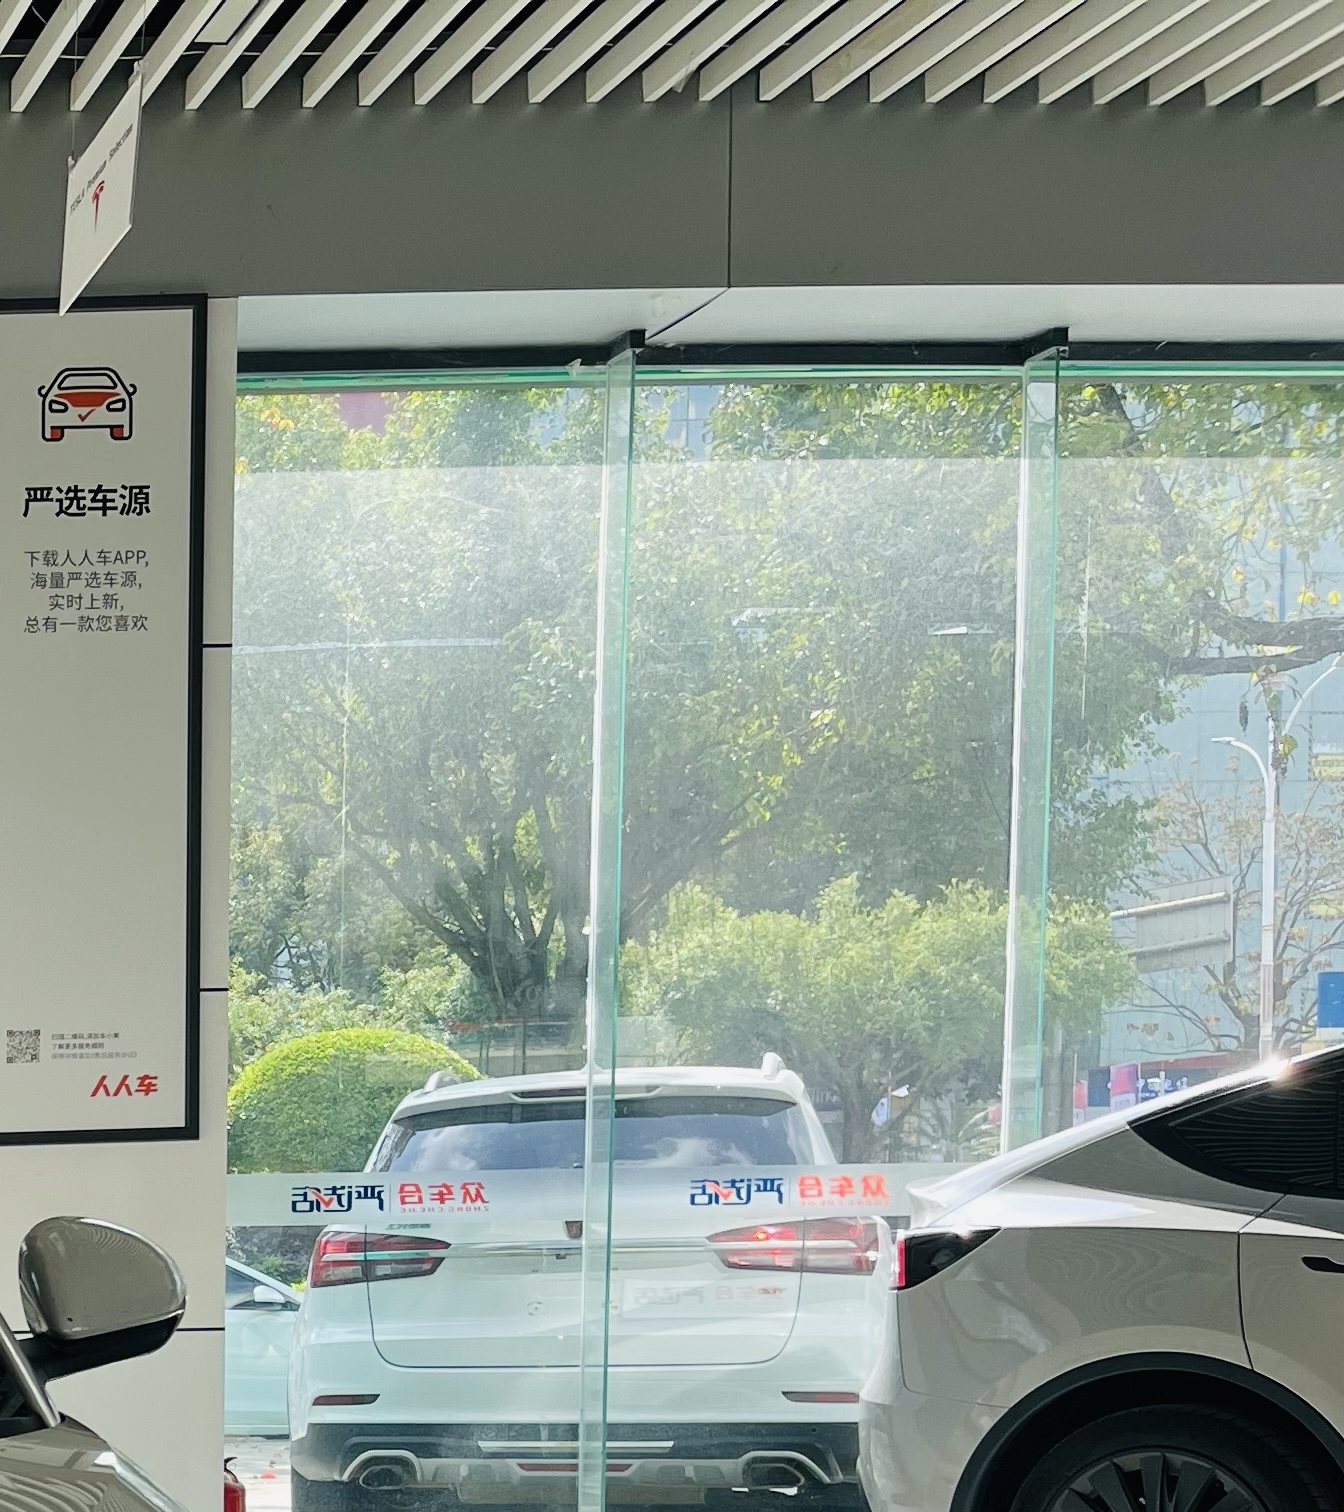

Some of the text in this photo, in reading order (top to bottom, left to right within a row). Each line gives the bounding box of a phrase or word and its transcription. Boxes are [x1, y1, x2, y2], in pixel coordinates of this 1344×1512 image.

[22, 484, 151, 518] 严选车源
[23, 614, 149, 634] 总有一款您喜欢
[90, 1074, 159, 1098] 人人车
